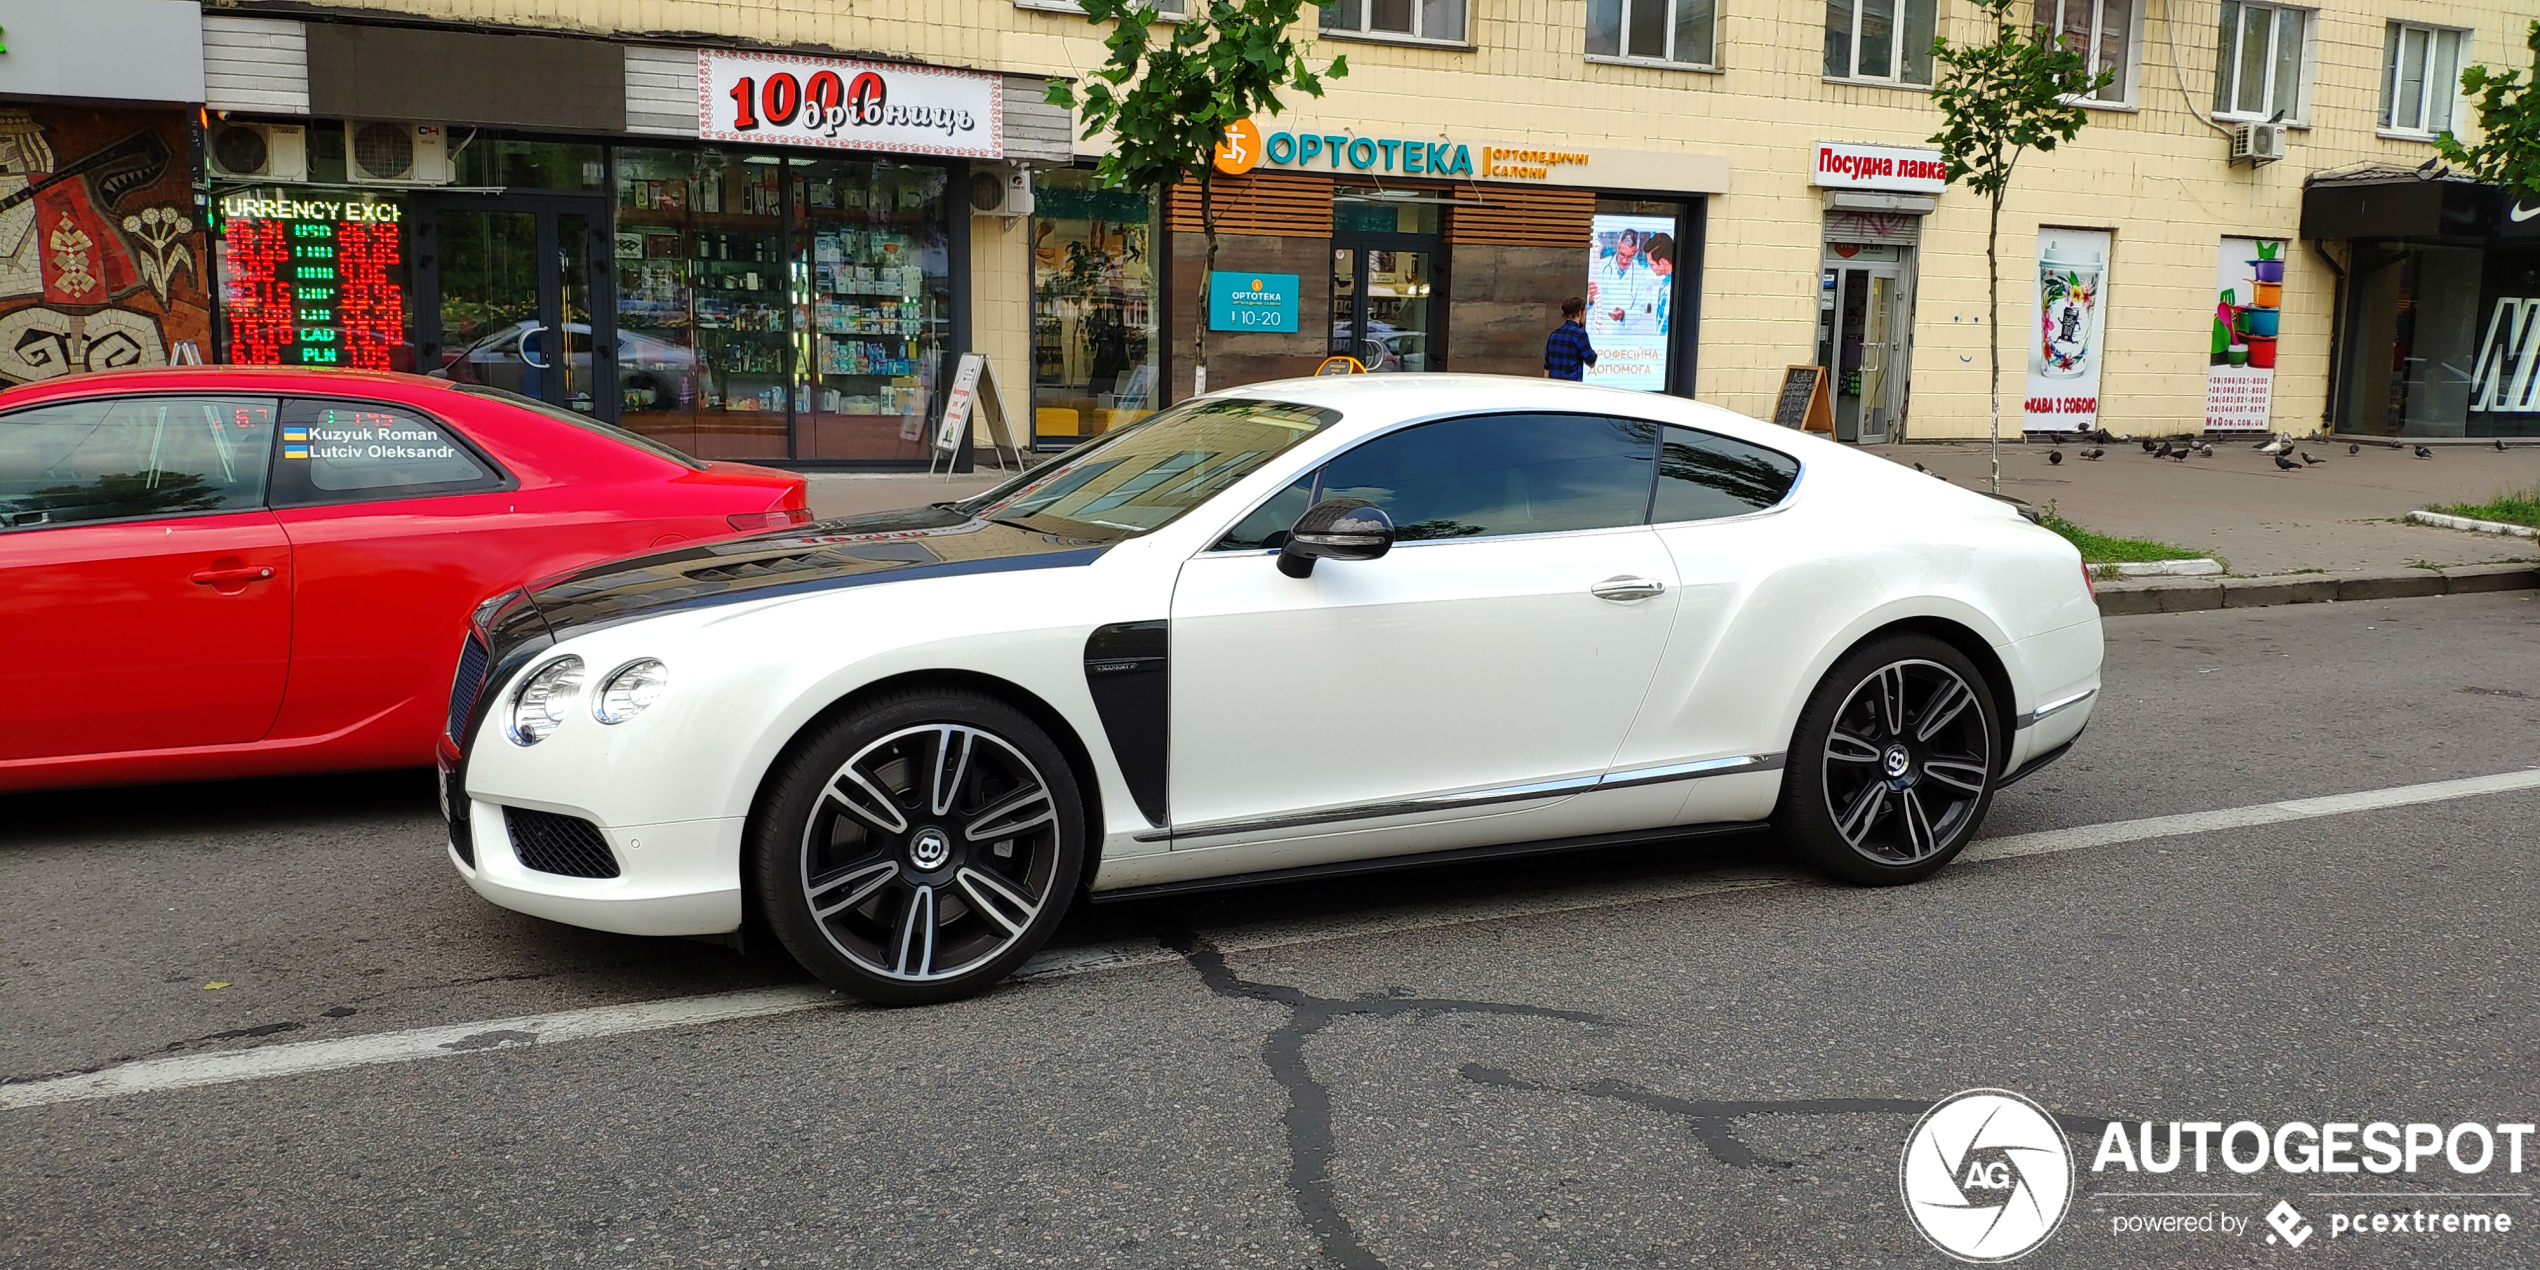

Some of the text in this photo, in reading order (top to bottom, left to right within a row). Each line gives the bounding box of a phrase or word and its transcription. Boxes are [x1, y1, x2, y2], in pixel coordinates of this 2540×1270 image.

[730, 70, 887, 131] 1000
[802, 96, 976, 136] дрібниць
[1267, 132, 1473, 175] ОРТОТЕКА
[1493, 148, 1589, 166] ОРТОПЕДИЧНІ
[1493, 165, 1547, 178] САЛОНИ
[1819, 148, 1947, 180] Посудна лавка
[295, 224, 332, 237] USD
[1232, 291, 1282, 301] ОРТОТЕКА
[1241, 311, 1281, 326] 10-20
[301, 328, 336, 341] CAD
[231, 344, 280, 365] 6.85
[303, 348, 338, 362] PLN
[1587, 364, 1652, 377] ДОПОМОГА
[2064, 397, 2096, 413] СОБОЮ
[309, 428, 438, 444] Kuzyuk Roman
[310, 445, 454, 458] Lutciv Oleksandr
